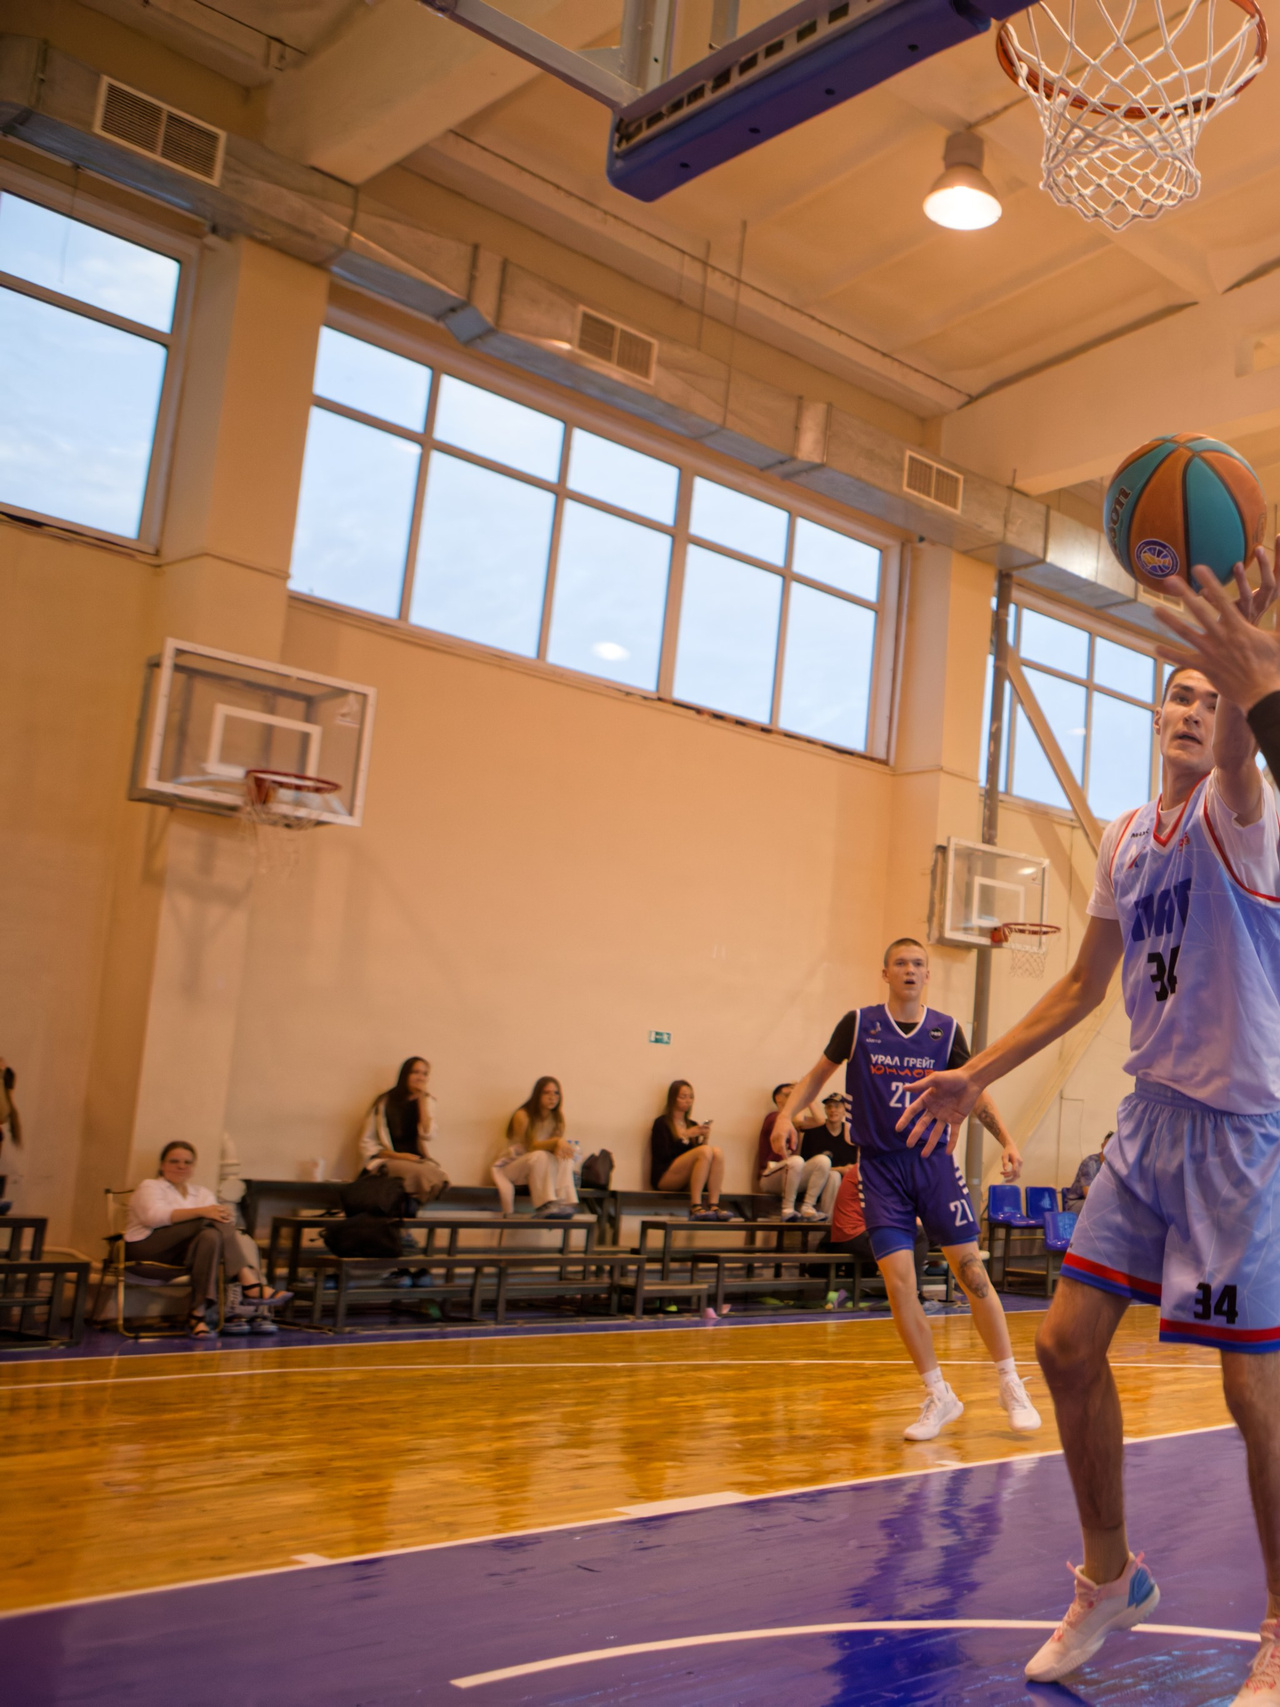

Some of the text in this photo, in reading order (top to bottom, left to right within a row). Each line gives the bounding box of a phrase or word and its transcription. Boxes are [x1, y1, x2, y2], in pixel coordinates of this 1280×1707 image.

[1147, 944, 1179, 1002] 34
[870, 1053, 936, 1069] УРАЛ ГРЕЙТ
[949, 1199, 974, 1227] 21
[1193, 1282, 1239, 1324] 34
